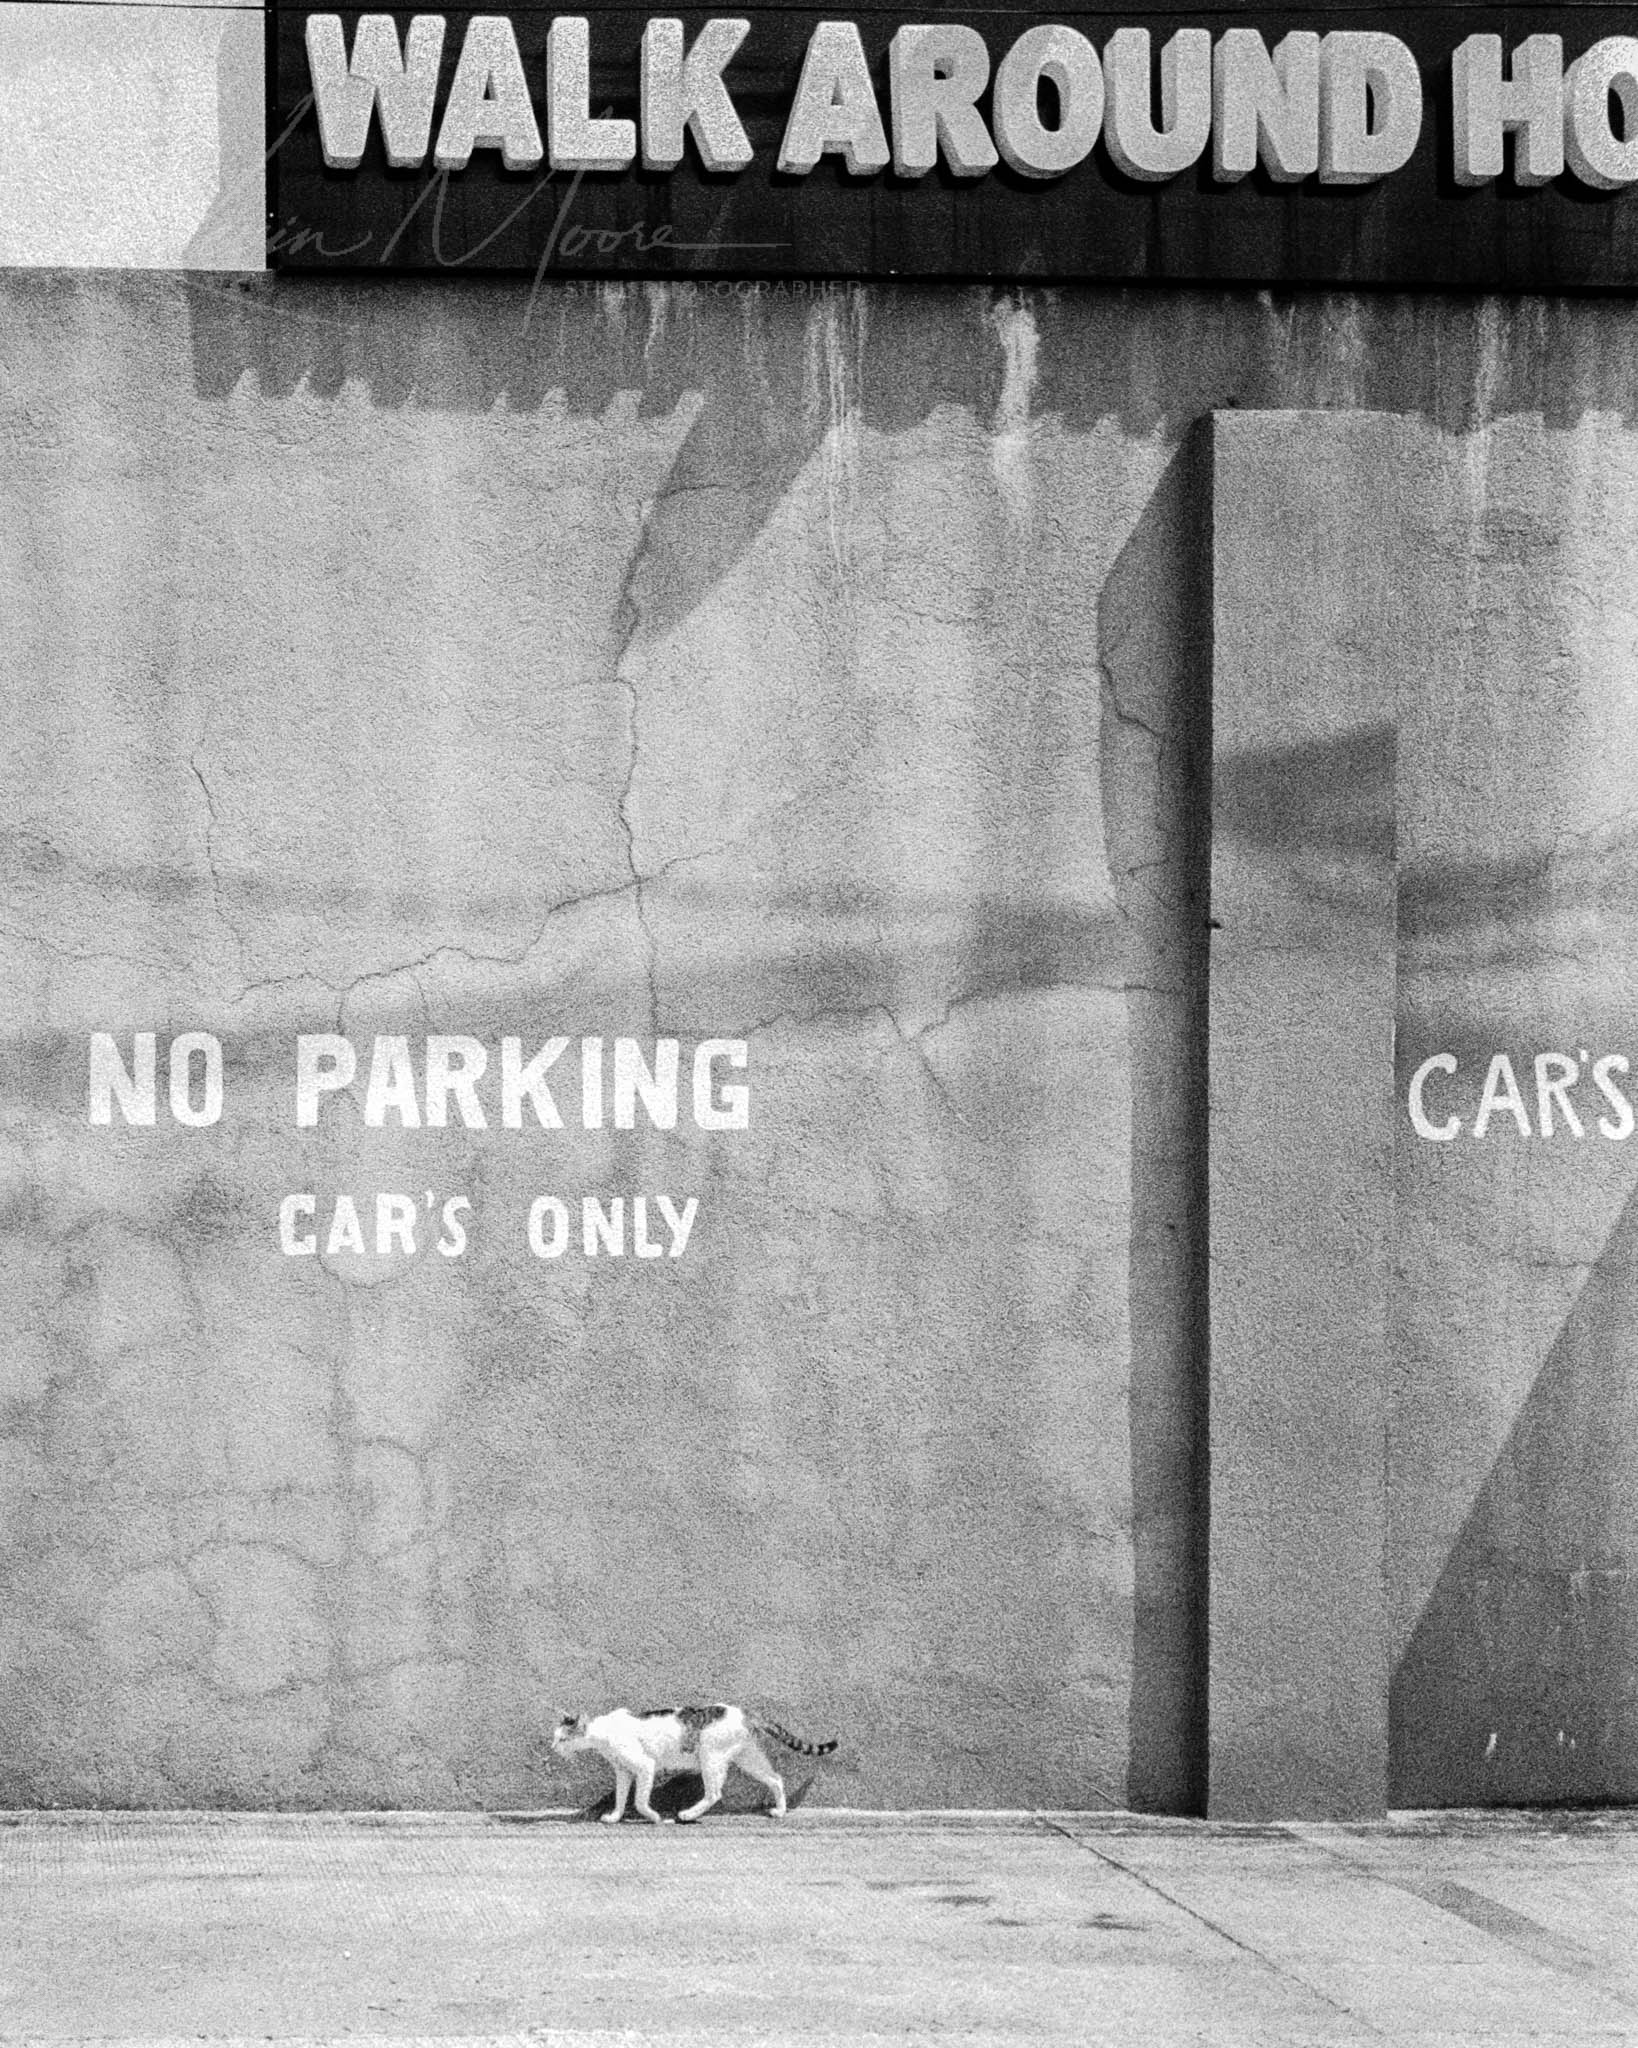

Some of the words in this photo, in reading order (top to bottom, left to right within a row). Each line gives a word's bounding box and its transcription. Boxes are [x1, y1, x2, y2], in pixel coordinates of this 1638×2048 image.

[305, 13, 755, 172] WALK
[777, 20, 1424, 183] AROUND
[1452, 33, 1638, 190] HO
[89, 1032, 224, 1127] NO
[296, 1035, 749, 1130] PARKING
[1408, 1049, 1636, 1141] CAR'S
[279, 1191, 471, 1257] CAR'S
[528, 1195, 699, 1259] ONLY
